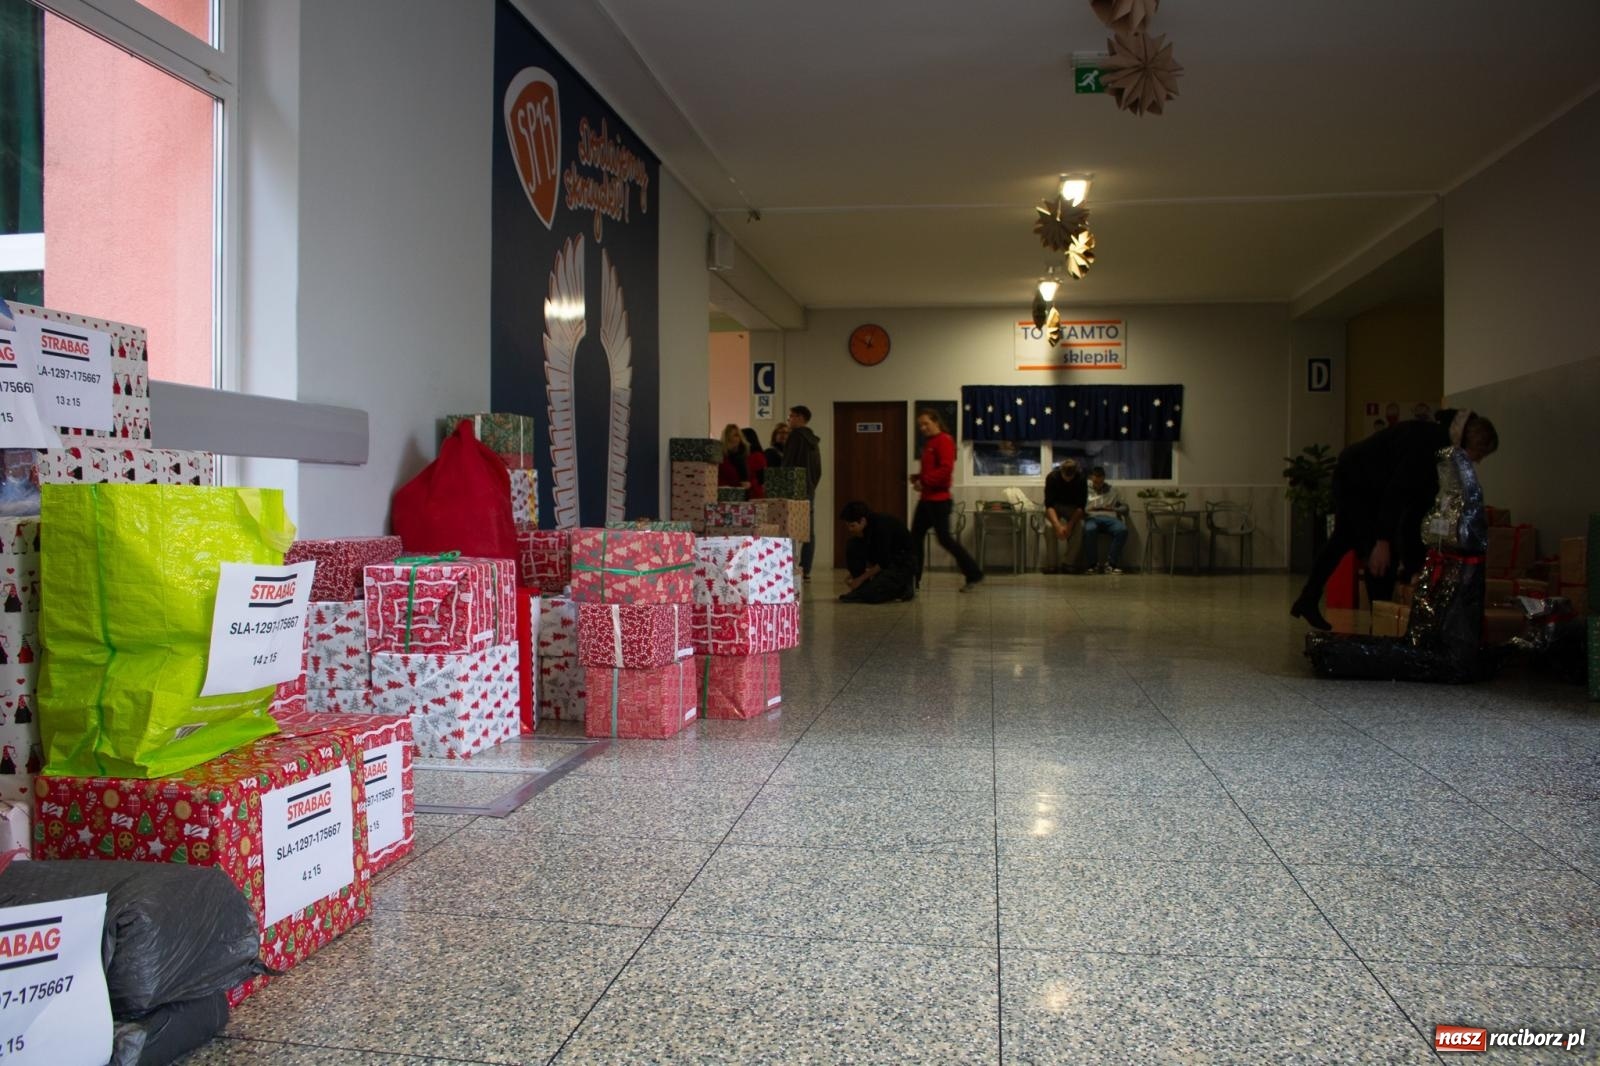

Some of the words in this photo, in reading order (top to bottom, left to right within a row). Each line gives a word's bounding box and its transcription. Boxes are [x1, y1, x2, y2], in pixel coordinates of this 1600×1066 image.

[518, 95, 556, 193] SP15
[1021, 326, 1043, 340] TO
[41, 335, 90, 355] STRABAG
[1063, 349, 1119, 365] sklepik
[757, 365, 772, 392] C
[1311, 362, 1329, 389] D
[56, 395, 65, 406] 13
[73, 398, 81, 407] 15
[0, 412, 14, 422] 15
[250, 582, 296, 600] STRABAG
[229, 616, 299, 635] SLA-1297-175667
[253, 655, 262, 666] 14
[263, 656, 268, 664] z
[269, 652, 278, 663] 15
[287, 791, 332, 821] STRABAG
[276, 822, 342, 860] SLA-1297-175667
[302, 870, 307, 881] 4
[308, 870, 312, 879] z
[313, 864, 322, 875] 15
[0, 975, 74, 1009] 7-175667
[7, 1034, 25, 1053] 15
